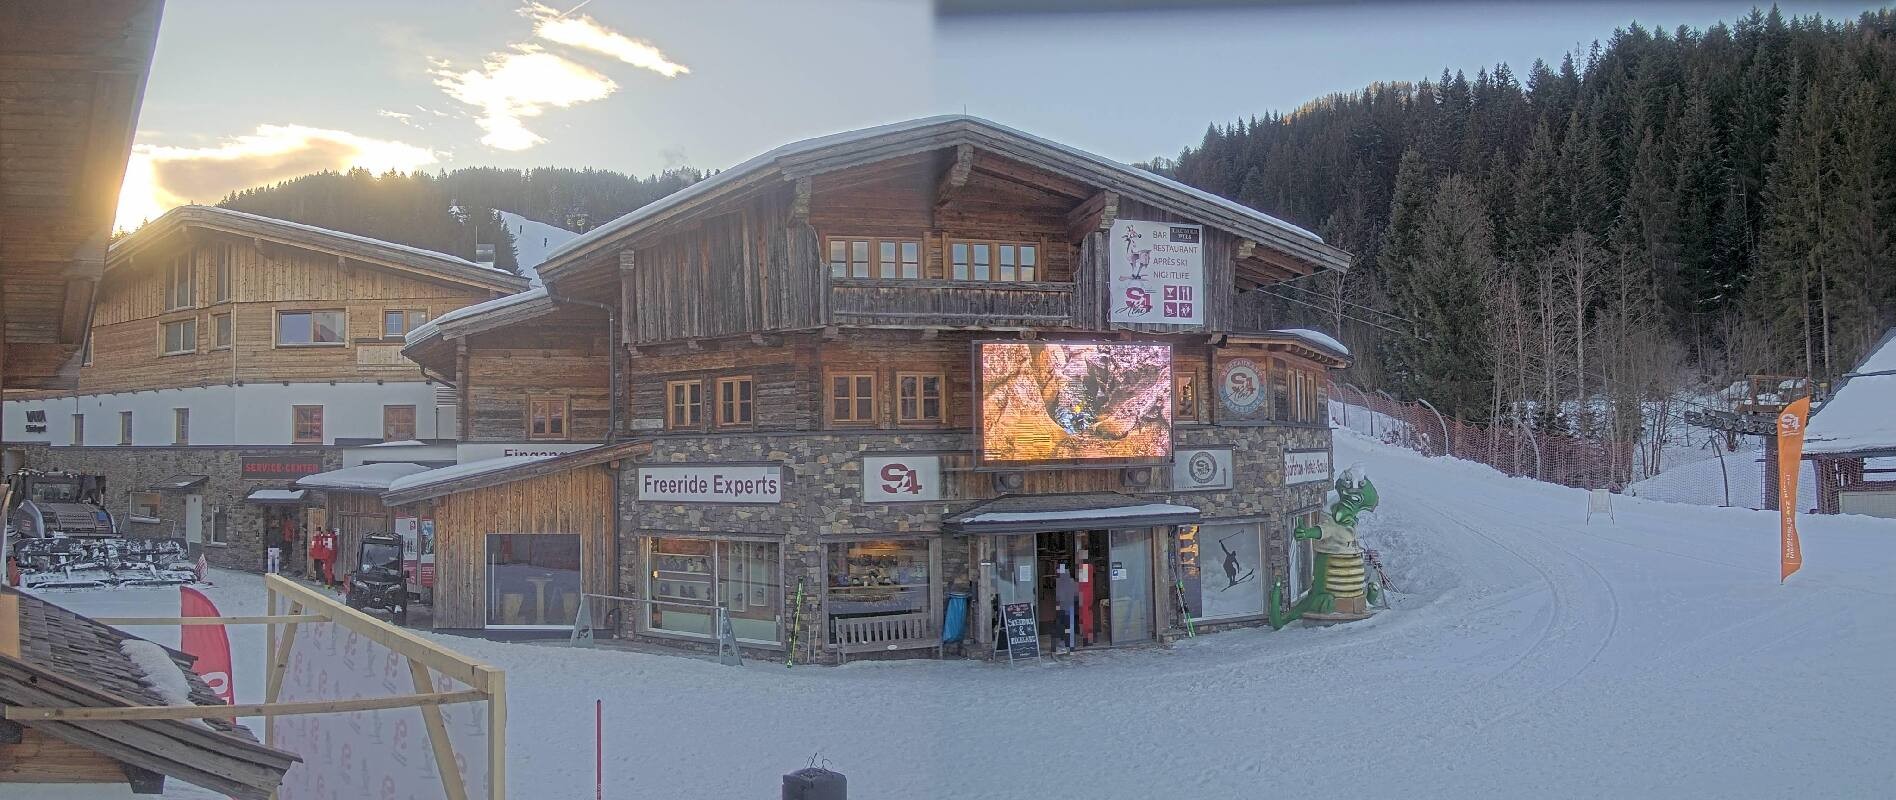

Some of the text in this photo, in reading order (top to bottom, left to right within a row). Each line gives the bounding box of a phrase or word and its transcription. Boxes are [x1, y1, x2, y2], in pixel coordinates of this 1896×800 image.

[1153, 231, 1167, 239] BAR
[1153, 244, 1198, 254] RESTAURANT
[1177, 259, 1188, 267] SKI
[1153, 271, 1190, 280] NIGHTLIFE
[644, 474, 777, 498] Freeride Experts
